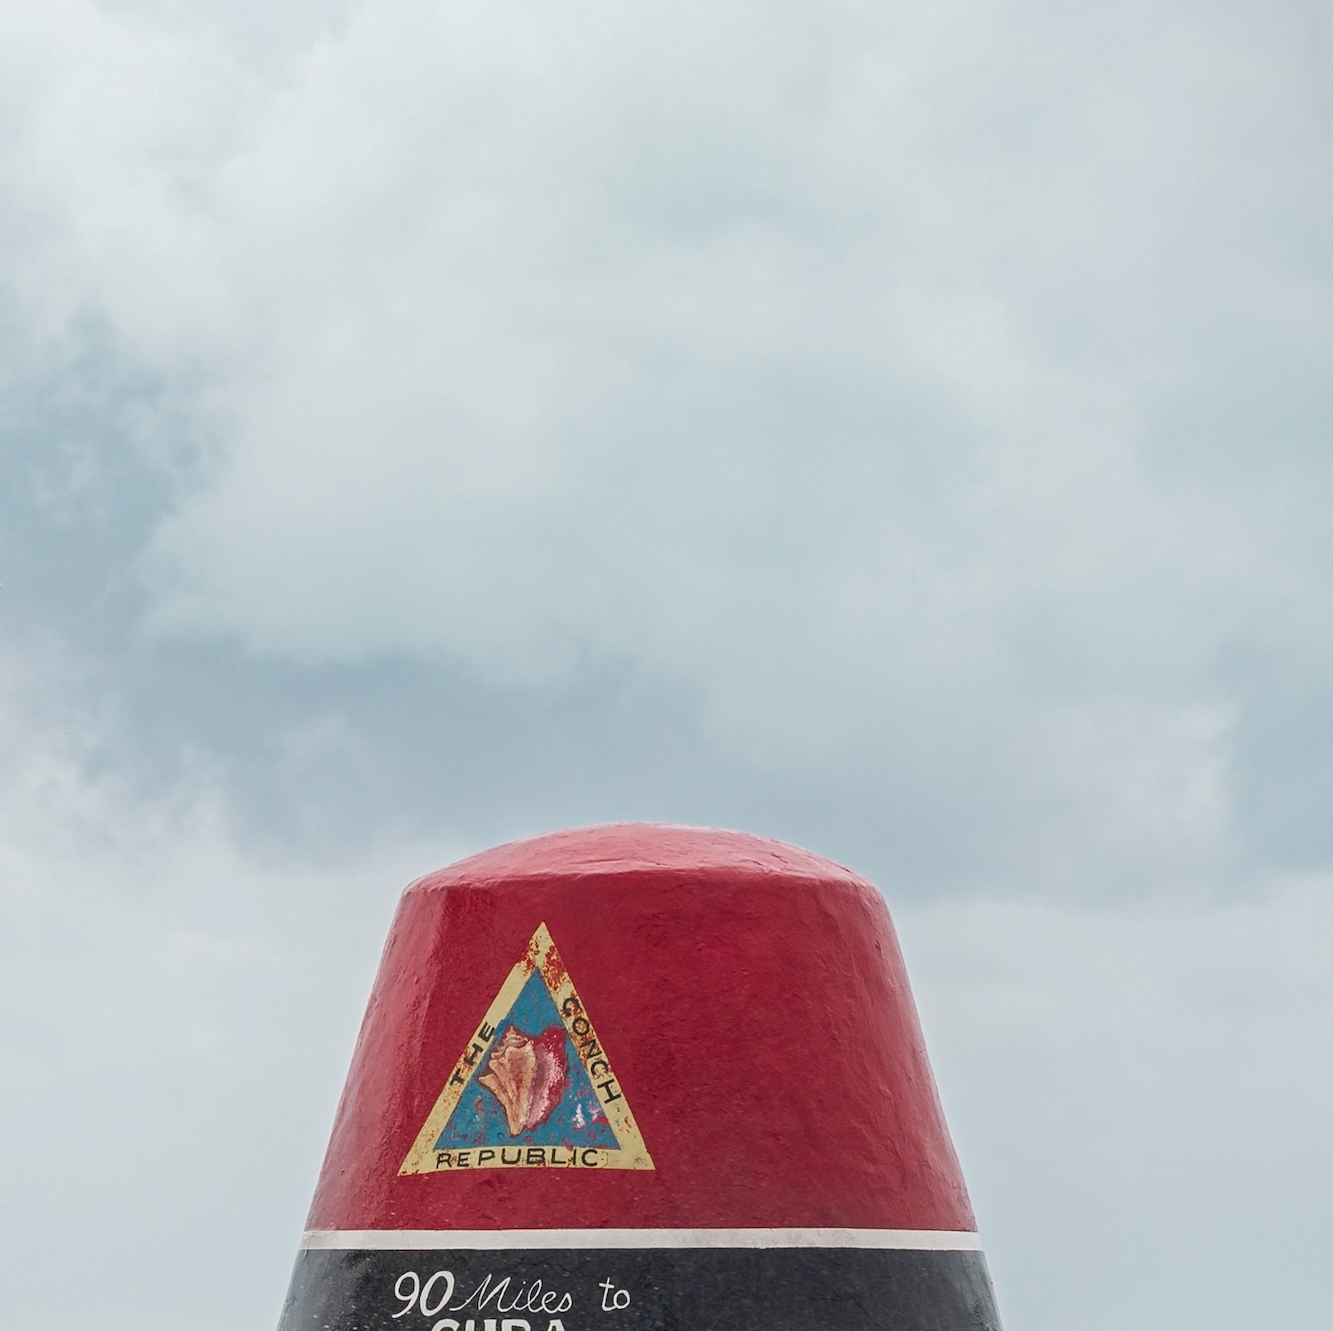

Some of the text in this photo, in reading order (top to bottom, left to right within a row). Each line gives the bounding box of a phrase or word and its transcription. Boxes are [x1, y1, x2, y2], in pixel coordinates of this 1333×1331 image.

[450, 1021, 495, 1087] THE
[562, 997, 622, 1104] CONCH
[435, 1147, 599, 1170] REPUBLIC
[393, 1270, 630, 1318] 90 Miles to
